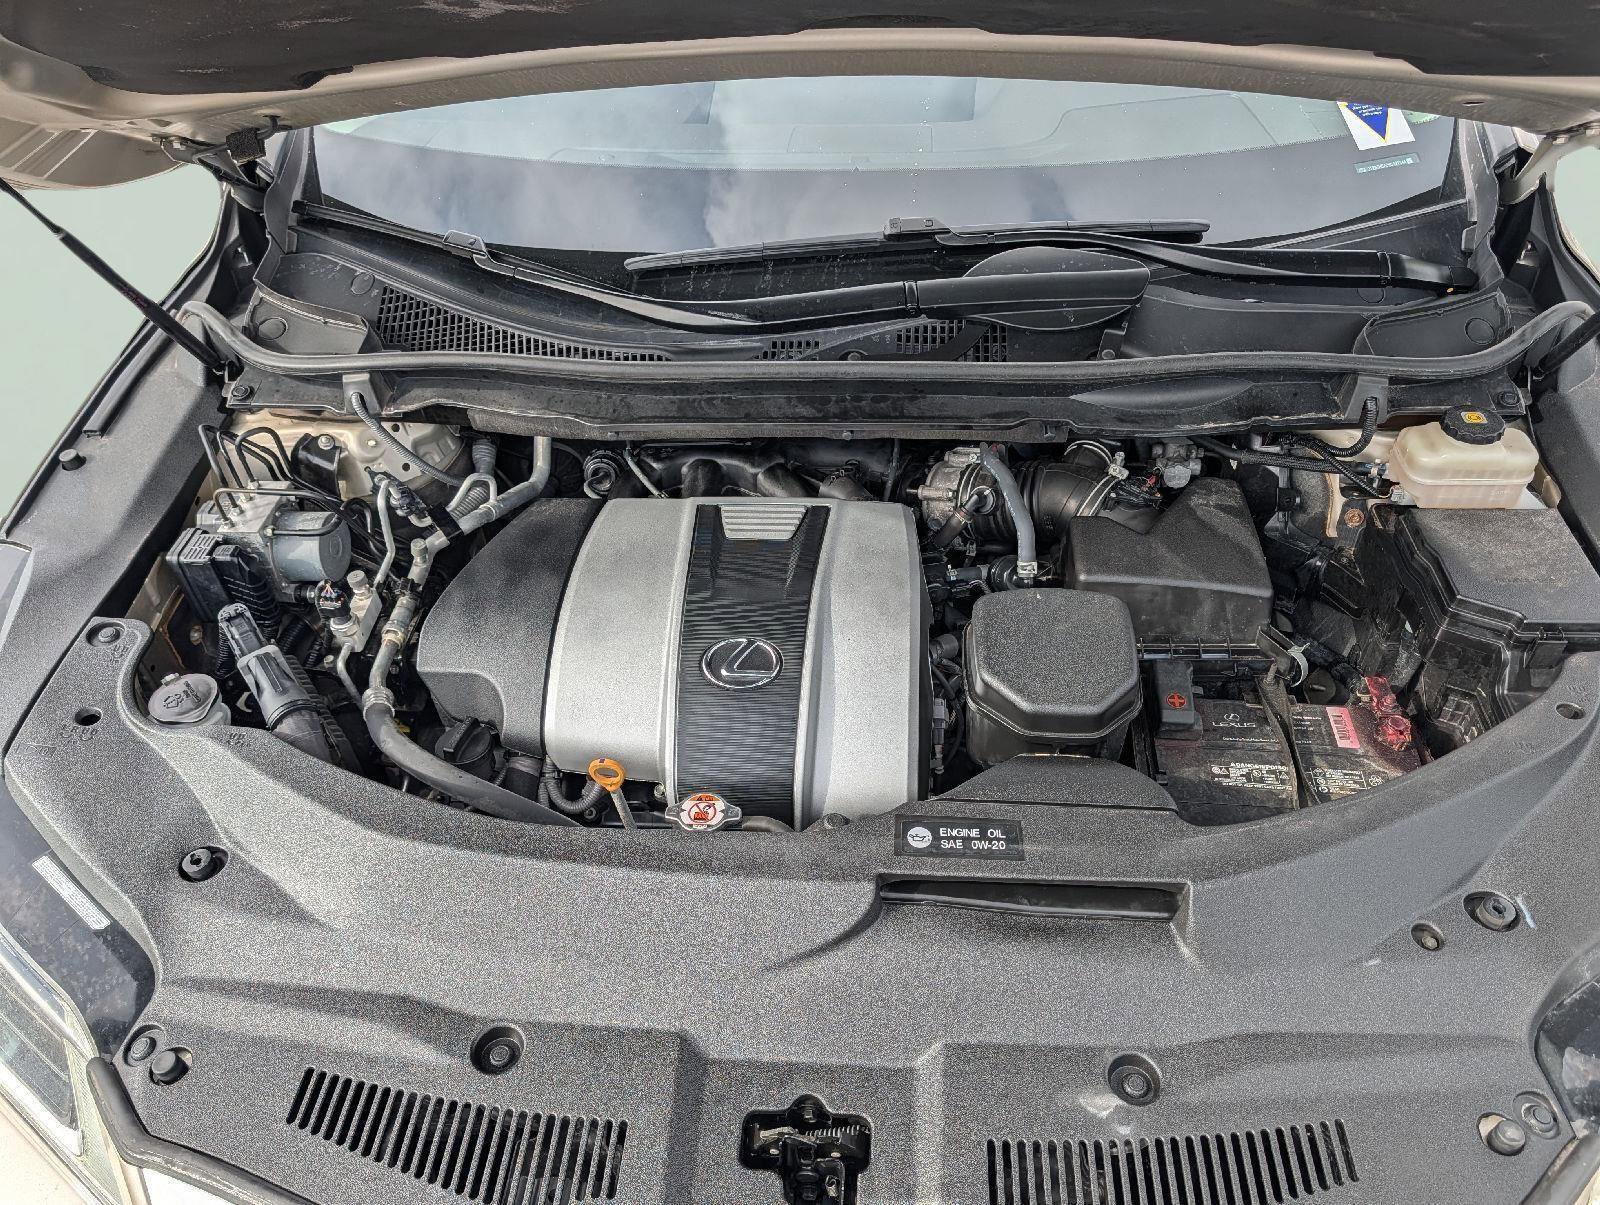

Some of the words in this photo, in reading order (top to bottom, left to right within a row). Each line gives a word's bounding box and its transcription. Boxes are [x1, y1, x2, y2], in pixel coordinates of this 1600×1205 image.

[939, 827, 981, 838] ENGINE
[987, 829, 1007, 839] OIL
[940, 839, 964, 849] SAE
[971, 840, 1006, 850] 0W-20
